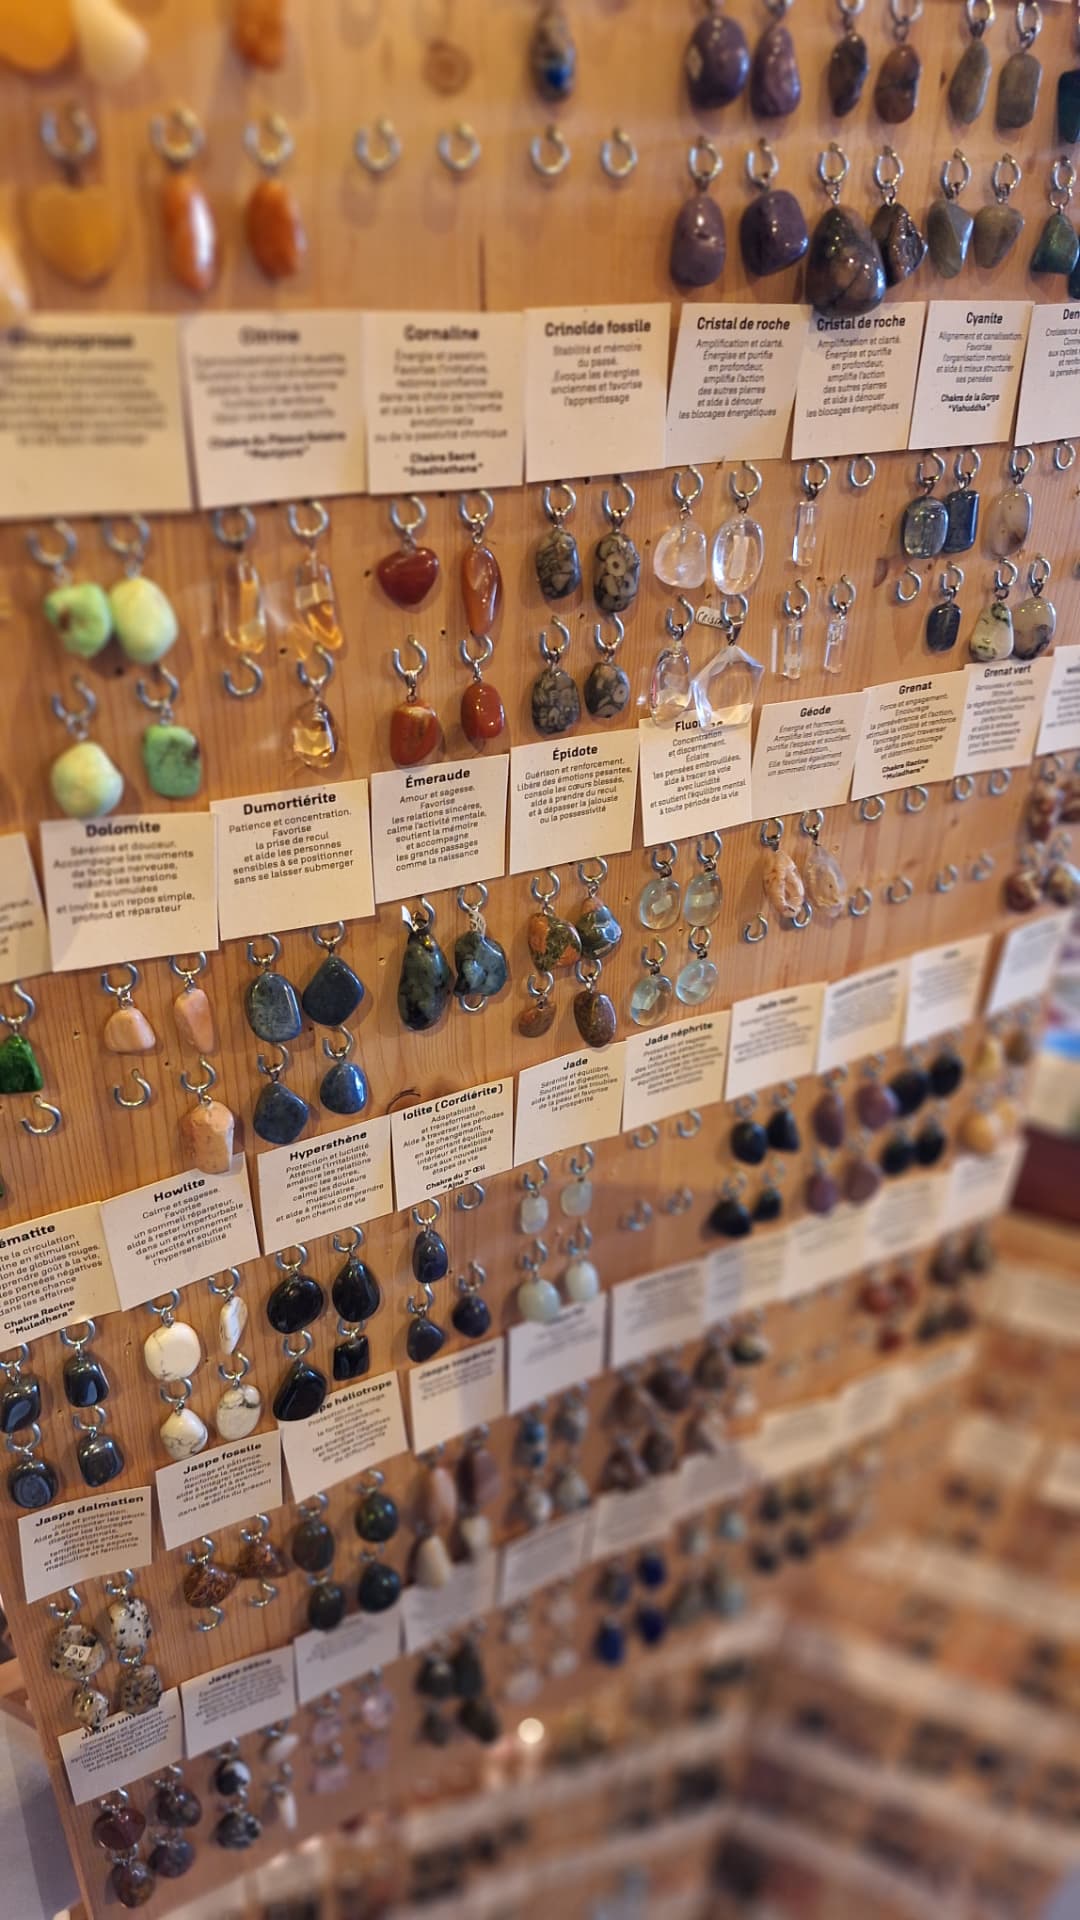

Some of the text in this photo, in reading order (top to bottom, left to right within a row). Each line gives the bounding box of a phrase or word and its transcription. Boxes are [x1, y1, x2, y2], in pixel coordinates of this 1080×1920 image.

[545, 319, 651, 336] Crinoïde fossile
[697, 317, 790, 330] Cristal de roche
[817, 314, 906, 331] Cristal de roche
[966, 312, 1003, 327] Cyanite
[984, 664, 1031, 678] Grenat vert
[899, 680, 932, 695] Grenat
[800, 706, 831, 717] Géode
[553, 746, 598, 762] Épidote
[406, 769, 471, 788] Émeraude
[525, 769, 560, 780] Guérison
[570, 758, 624, 773] renforcement.
[517, 782, 540, 792] Libère
[542, 779, 555, 787] des
[557, 774, 593, 785] émotions
[524, 788, 553, 800] console
[556, 786, 566, 794] les
[568, 783, 592, 792] cœurs
[243, 793, 336, 815] Dumortiérite
[400, 794, 428, 804] Amour
[420, 797, 456, 809] Favorise
[531, 785, 617, 807] aide à prendre du recul
[538, 807, 542, 815] à
[544, 803, 578, 815] dépasser
[579, 800, 587, 808] la
[588, 794, 618, 809] jalousie
[392, 816, 405, 824] les
[406, 810, 443, 822] relations
[551, 814, 558, 822] la
[560, 804, 606, 823] possessivité
[86, 822, 161, 837] Dolomite
[229, 821, 271, 833] Patience
[273, 818, 282, 826] et
[272, 824, 312, 836] Favorise
[387, 824, 413, 835] calme
[415, 815, 449, 830] l'activité
[395, 821, 479, 842] soutient la mémoire
[256, 831, 329, 850] la prise de recul
[396, 840, 478, 862] les grands passages
[406, 832, 469, 850] et accompagne
[244, 841, 341, 862] et aide les personnes
[396, 849, 479, 871] comme la naissance
[233, 850, 353, 875] sensibles à se positionner
[234, 860, 354, 885] sans se laisser submerger
[645, 1022, 713, 1046] Jade néphrite
[563, 1058, 588, 1070] Jade
[403, 1083, 503, 1120] Iolite (Cordiérite)
[290, 1132, 367, 1161] Hypersthène
[286, 1156, 328, 1173] Protection
[329, 1152, 337, 1160] et
[153, 1179, 205, 1202] Howlite
[142, 1204, 171, 1219] Calme
[173, 1200, 182, 1208] et
[164, 1202, 202, 1219] Favorise
[276, 1184, 384, 1222] et aide à mieux comprendre
[0, 1225, 56, 1249] ématite
[127, 1203, 244, 1250] aide à rester imperturbable
[134, 1231, 146, 1239] un
[147, 1214, 186, 1234] sommeil
[135, 1212, 238, 1255] dans un environnement
[11, 1234, 76, 1258] la circulation
[145, 1221, 232, 1260] surexcité et soutient
[20, 1240, 81, 1264] en stimulant
[17, 1265, 27, 1274] de
[29, 1255, 67, 1272] globules
[42, 1264, 62, 1277] goût
[72, 1258, 81, 1266] la
[16, 1261, 103, 1295] pensées négatives
[4, 1277, 77, 1306] apporte chance
[23, 1298, 38, 1307] les
[40, 1286, 74, 1302] affaires
[4, 1299, 75, 1329] Chakra Racine
[335, 1380, 392, 1405] héliotrope
[183, 1442, 262, 1474] Jaspe fossile
[35, 1496, 144, 1527] Jaspe dalmatien
